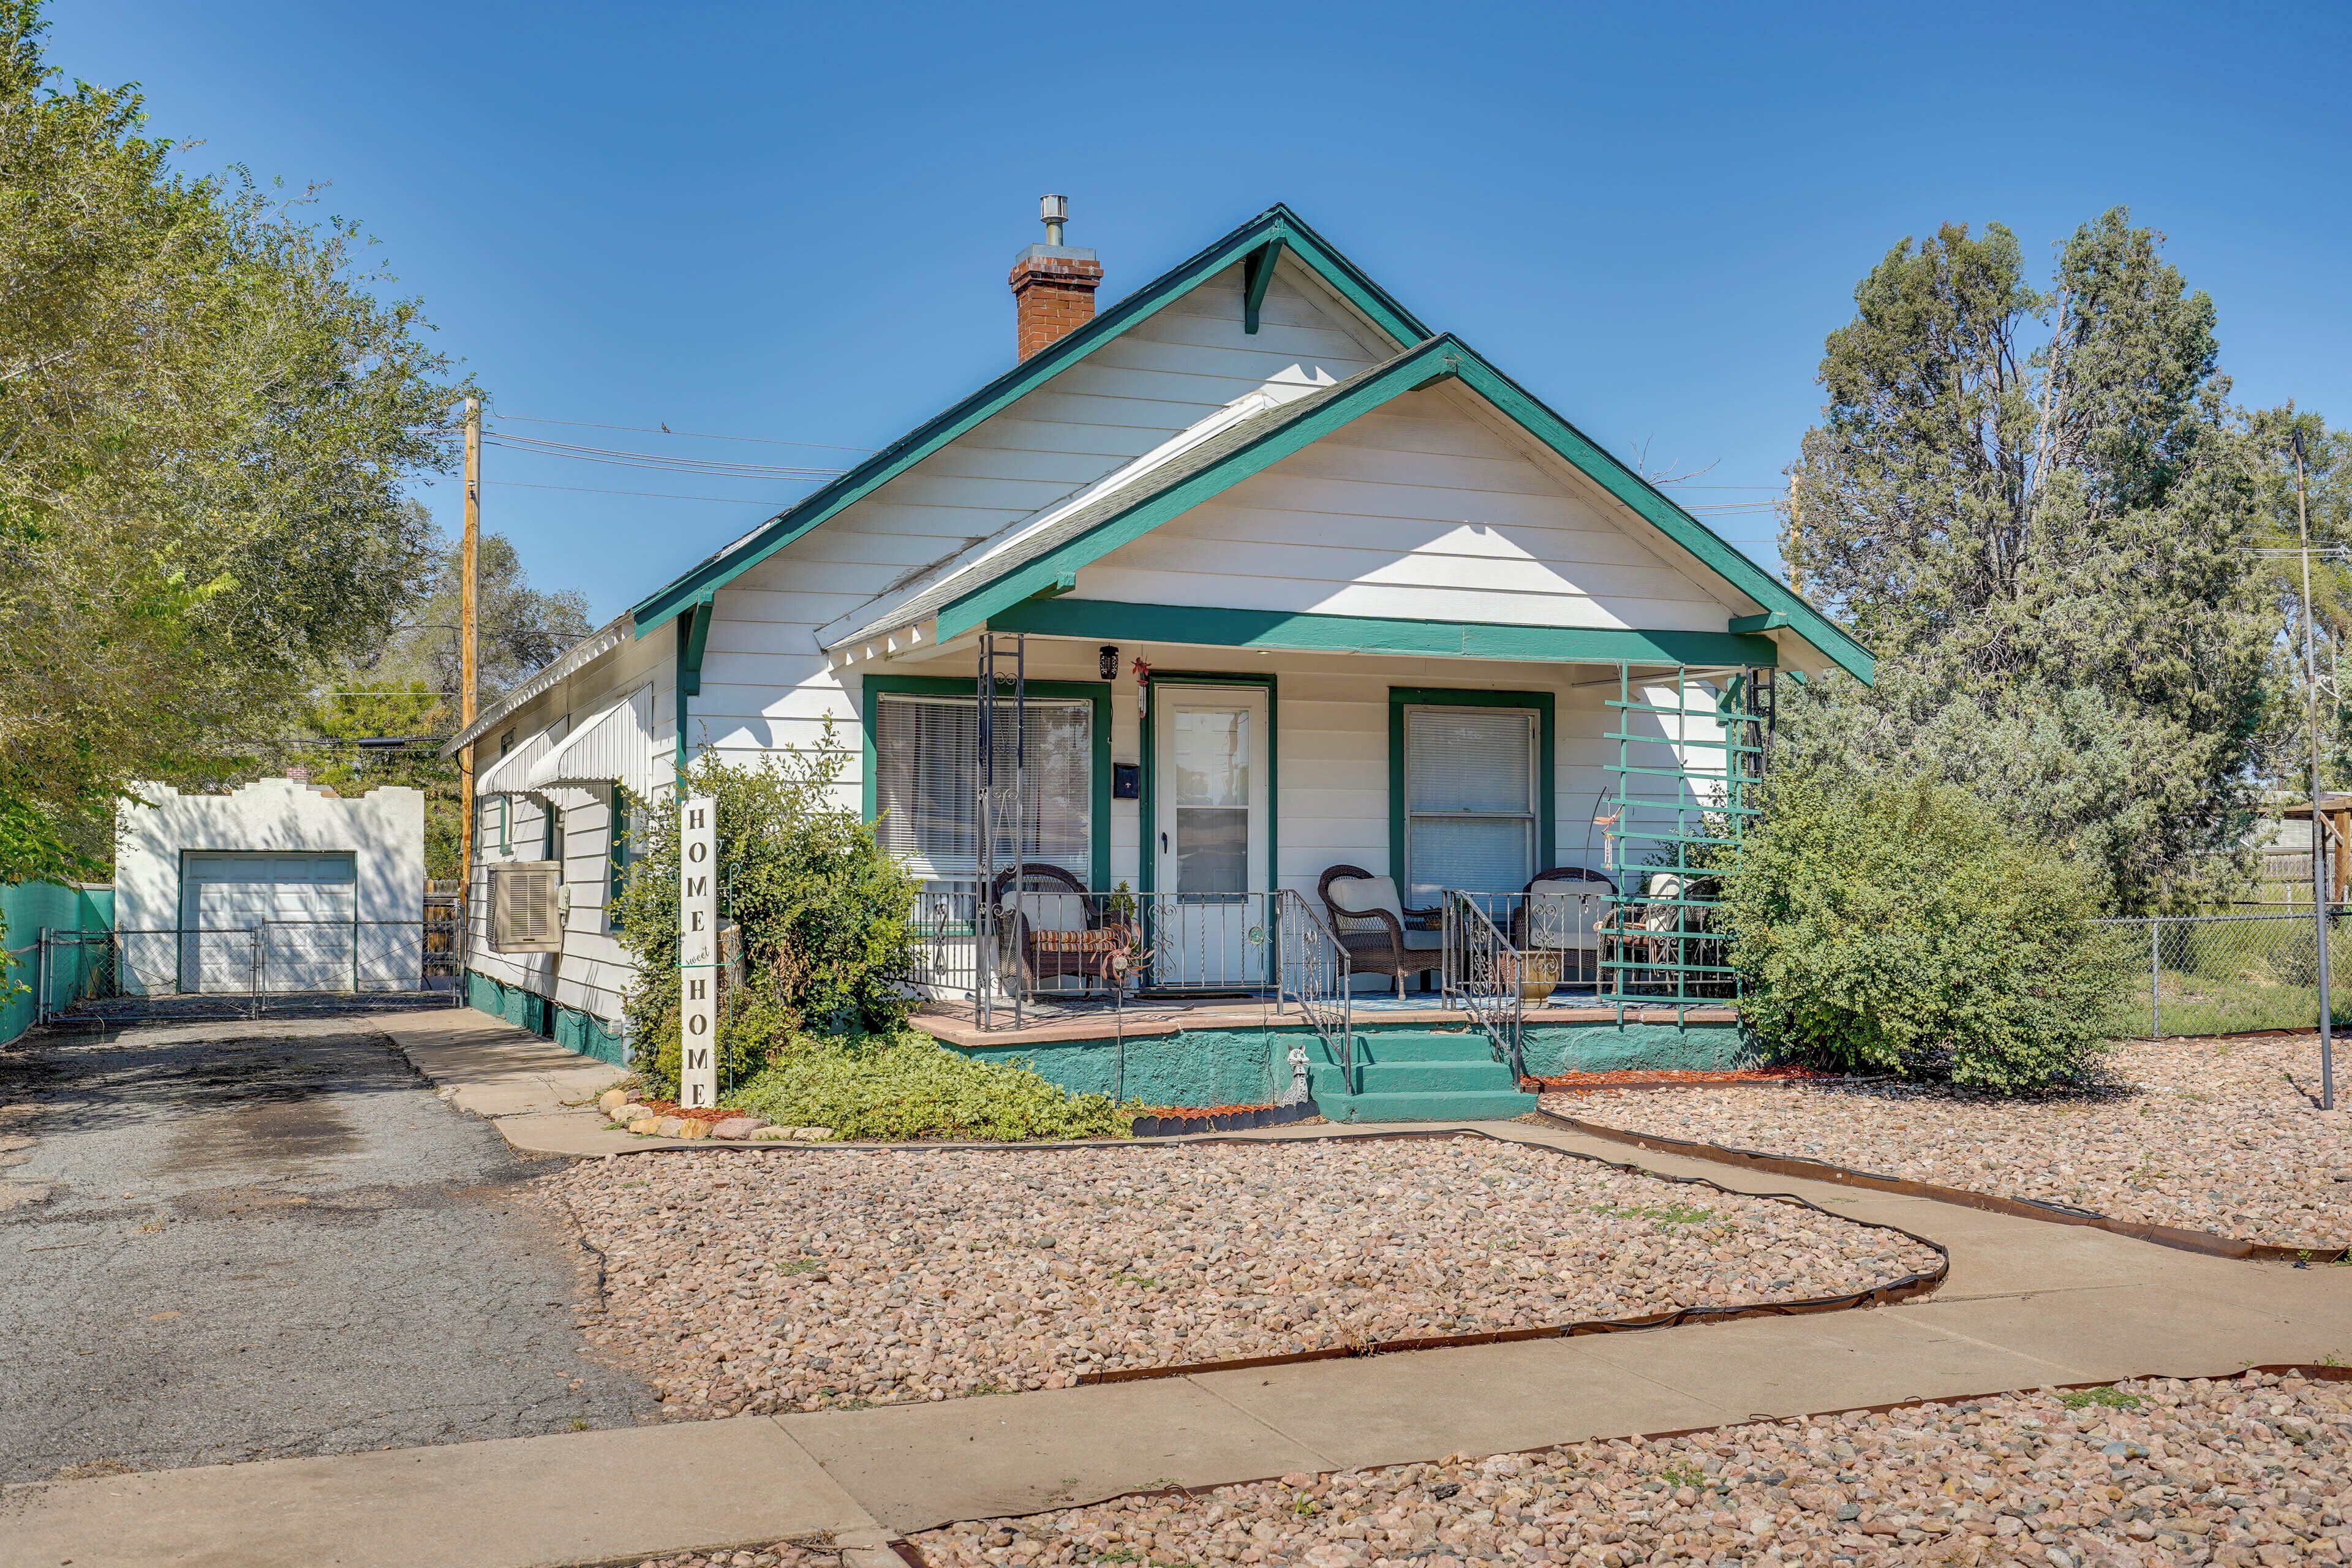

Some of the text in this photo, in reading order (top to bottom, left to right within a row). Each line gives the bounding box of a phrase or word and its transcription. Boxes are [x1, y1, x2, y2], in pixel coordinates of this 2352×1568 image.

[686, 808, 707, 932] HOME
[685, 946, 710, 966] sweet
[687, 979, 709, 1106] HOME
